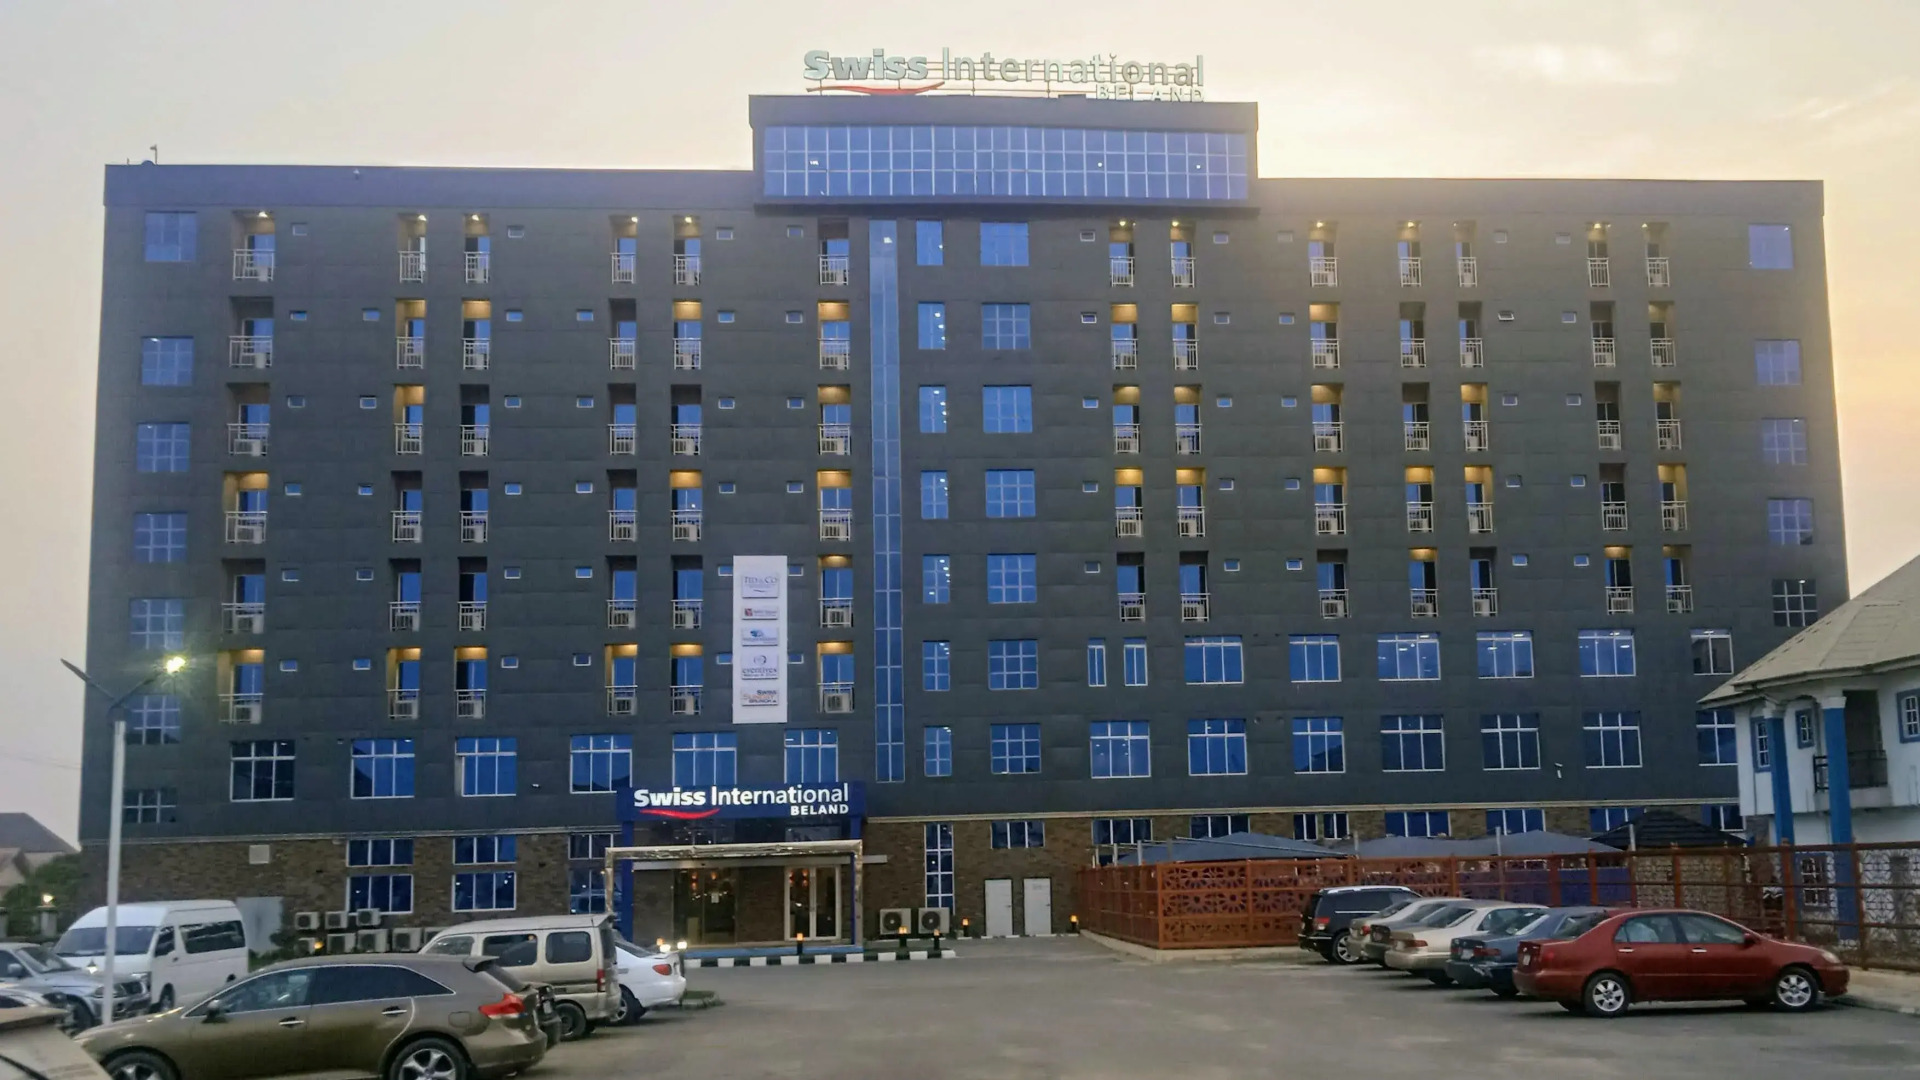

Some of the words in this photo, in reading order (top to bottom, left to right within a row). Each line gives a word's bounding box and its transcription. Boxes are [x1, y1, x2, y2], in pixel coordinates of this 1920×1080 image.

[803, 48, 927, 80] Swiss
[942, 47, 1205, 86] International
[1096, 83, 1205, 102] BELAND
[634, 787, 705, 807] Swiss
[711, 783, 849, 806] International
[790, 804, 849, 816] BELAND
